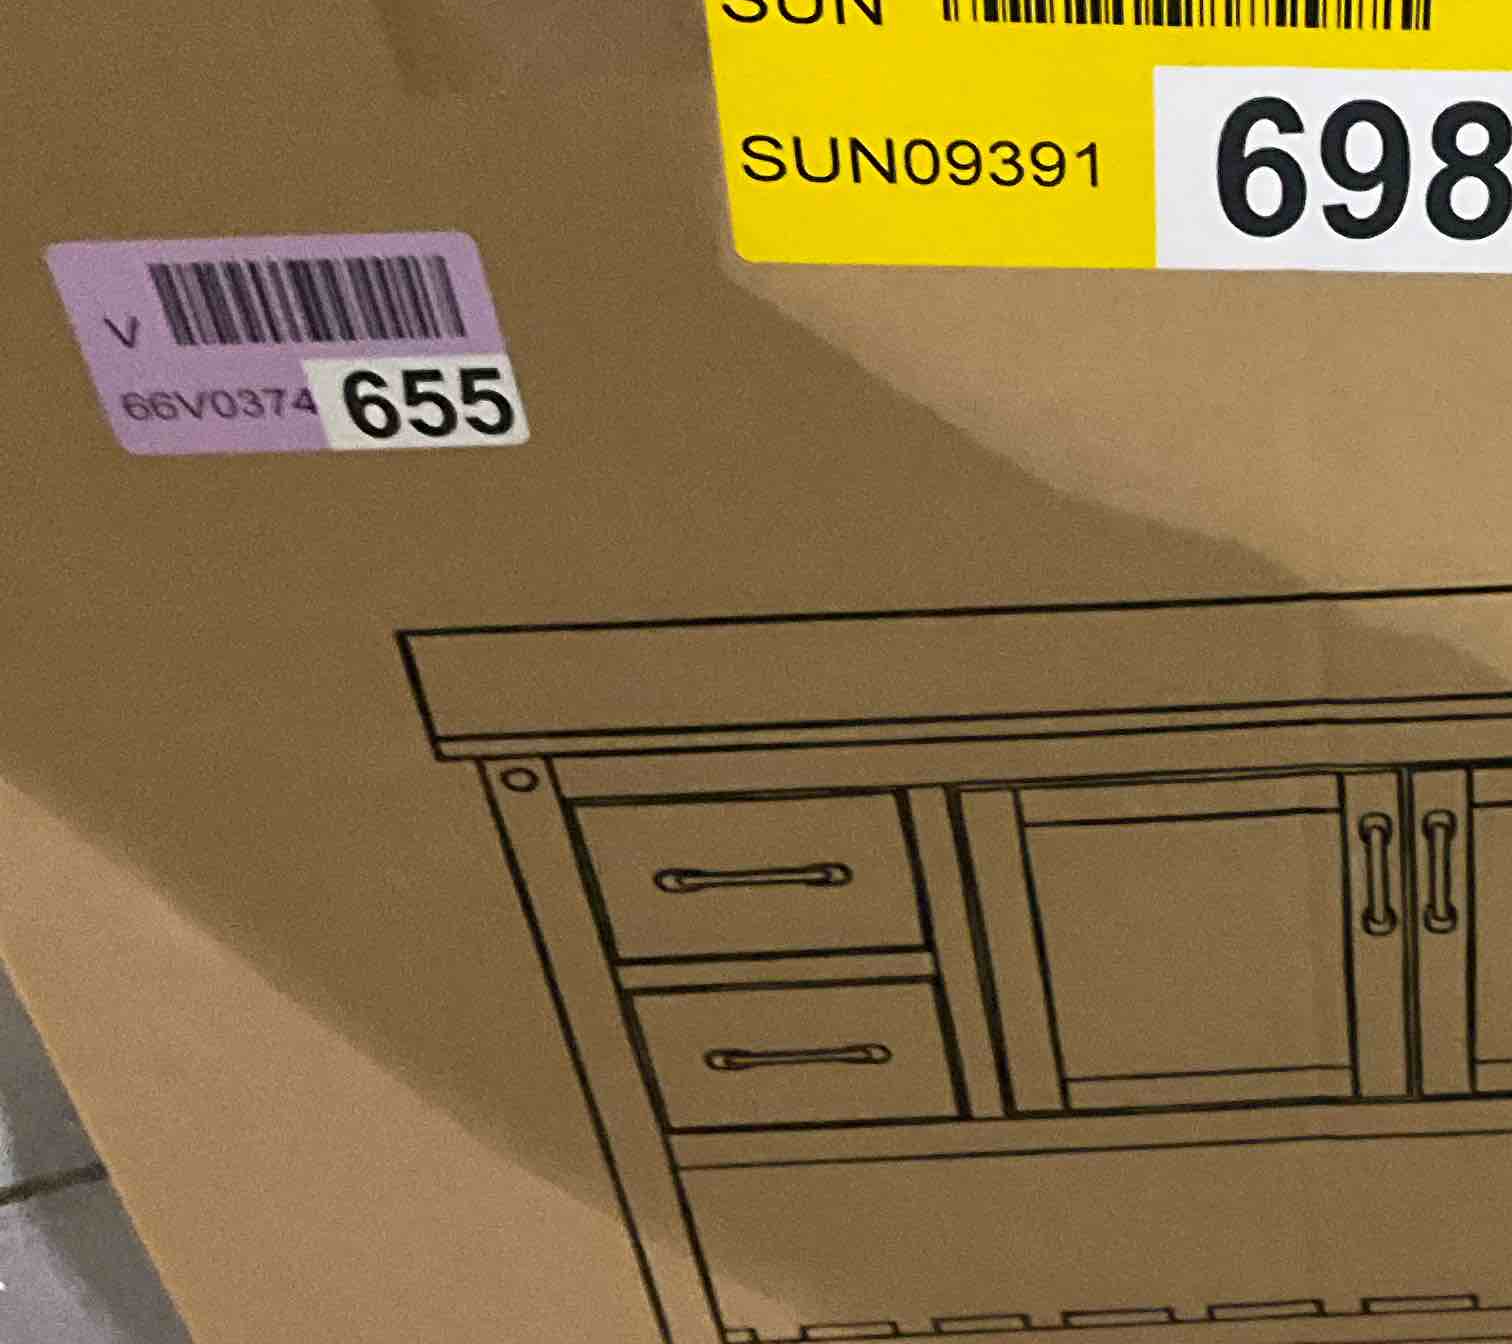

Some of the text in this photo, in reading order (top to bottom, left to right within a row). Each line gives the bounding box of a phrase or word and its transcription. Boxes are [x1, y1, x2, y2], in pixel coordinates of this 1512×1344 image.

[741, 133, 1103, 188] SUN09391
[104, 315, 139, 348] V
[343, 367, 515, 439] 655
